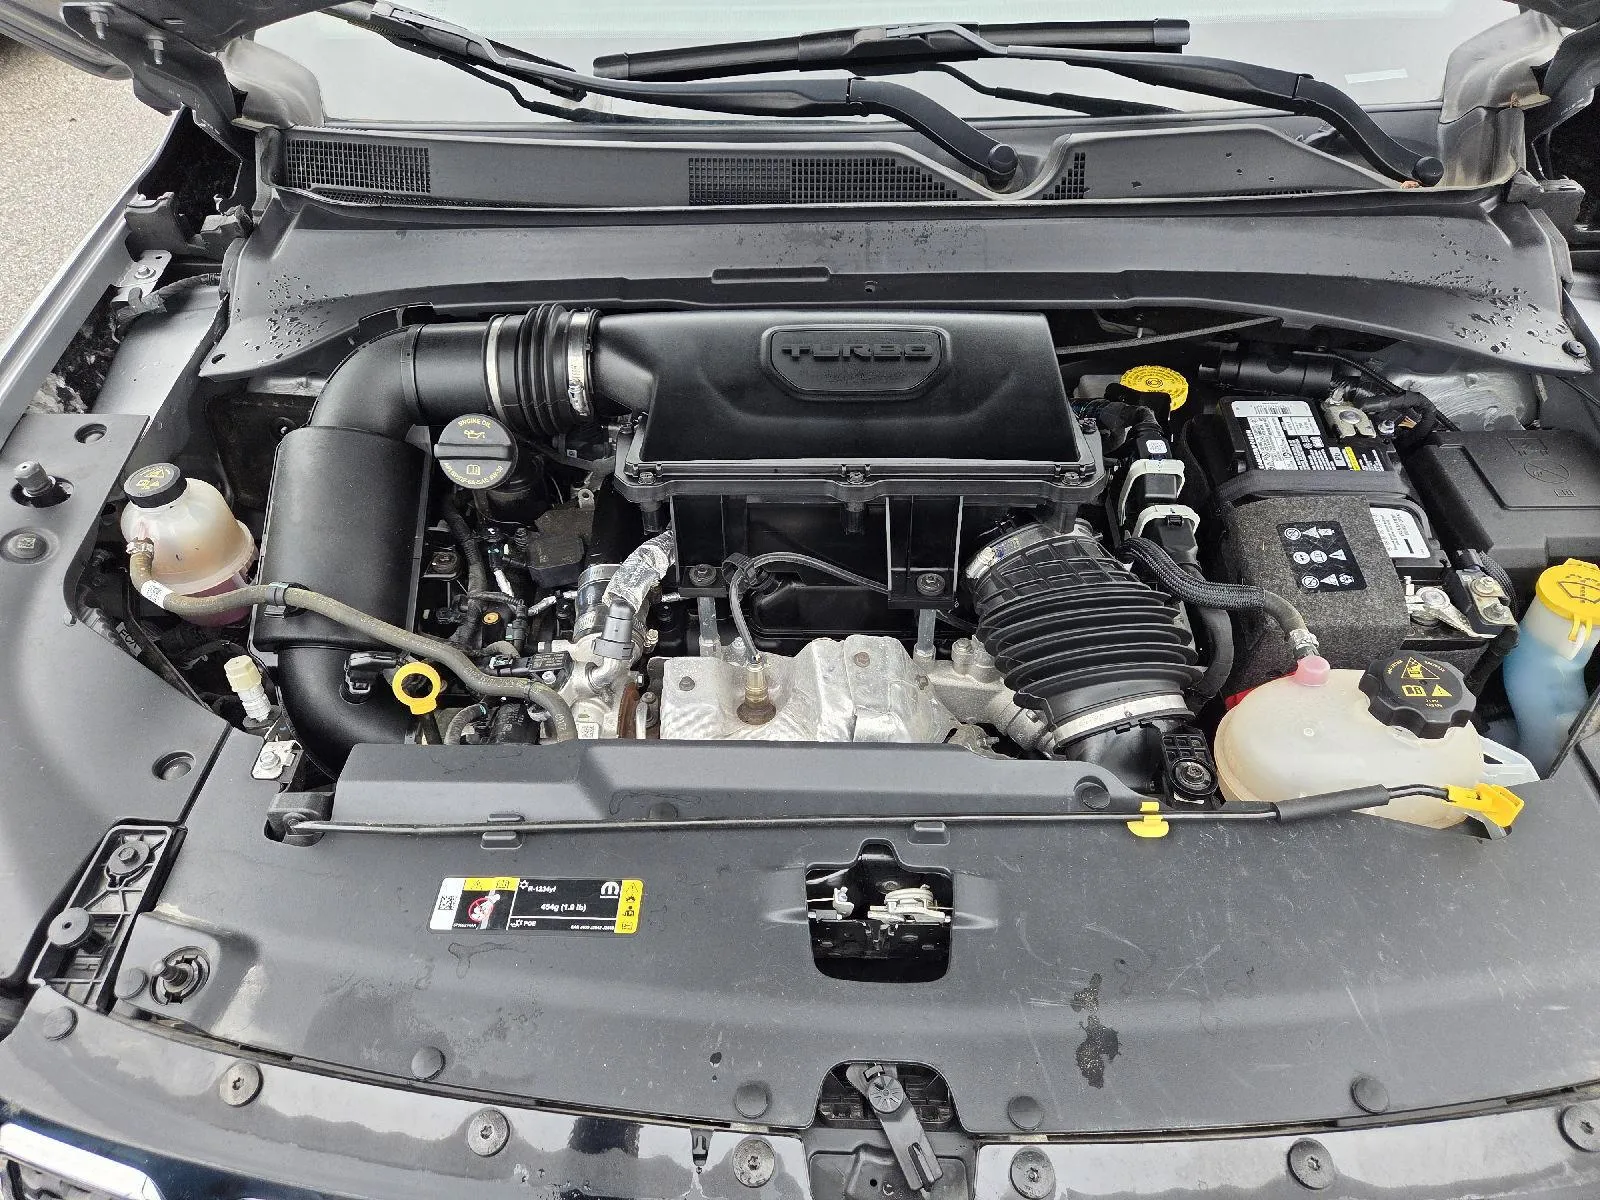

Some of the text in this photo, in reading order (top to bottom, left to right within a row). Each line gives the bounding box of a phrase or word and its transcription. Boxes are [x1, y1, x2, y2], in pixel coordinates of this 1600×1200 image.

[781, 343, 933, 361] TURBO
[458, 418, 491, 429] ENGINE OIL
[527, 885, 557, 894] R-1234yf
[540, 903, 560, 913] 454g
